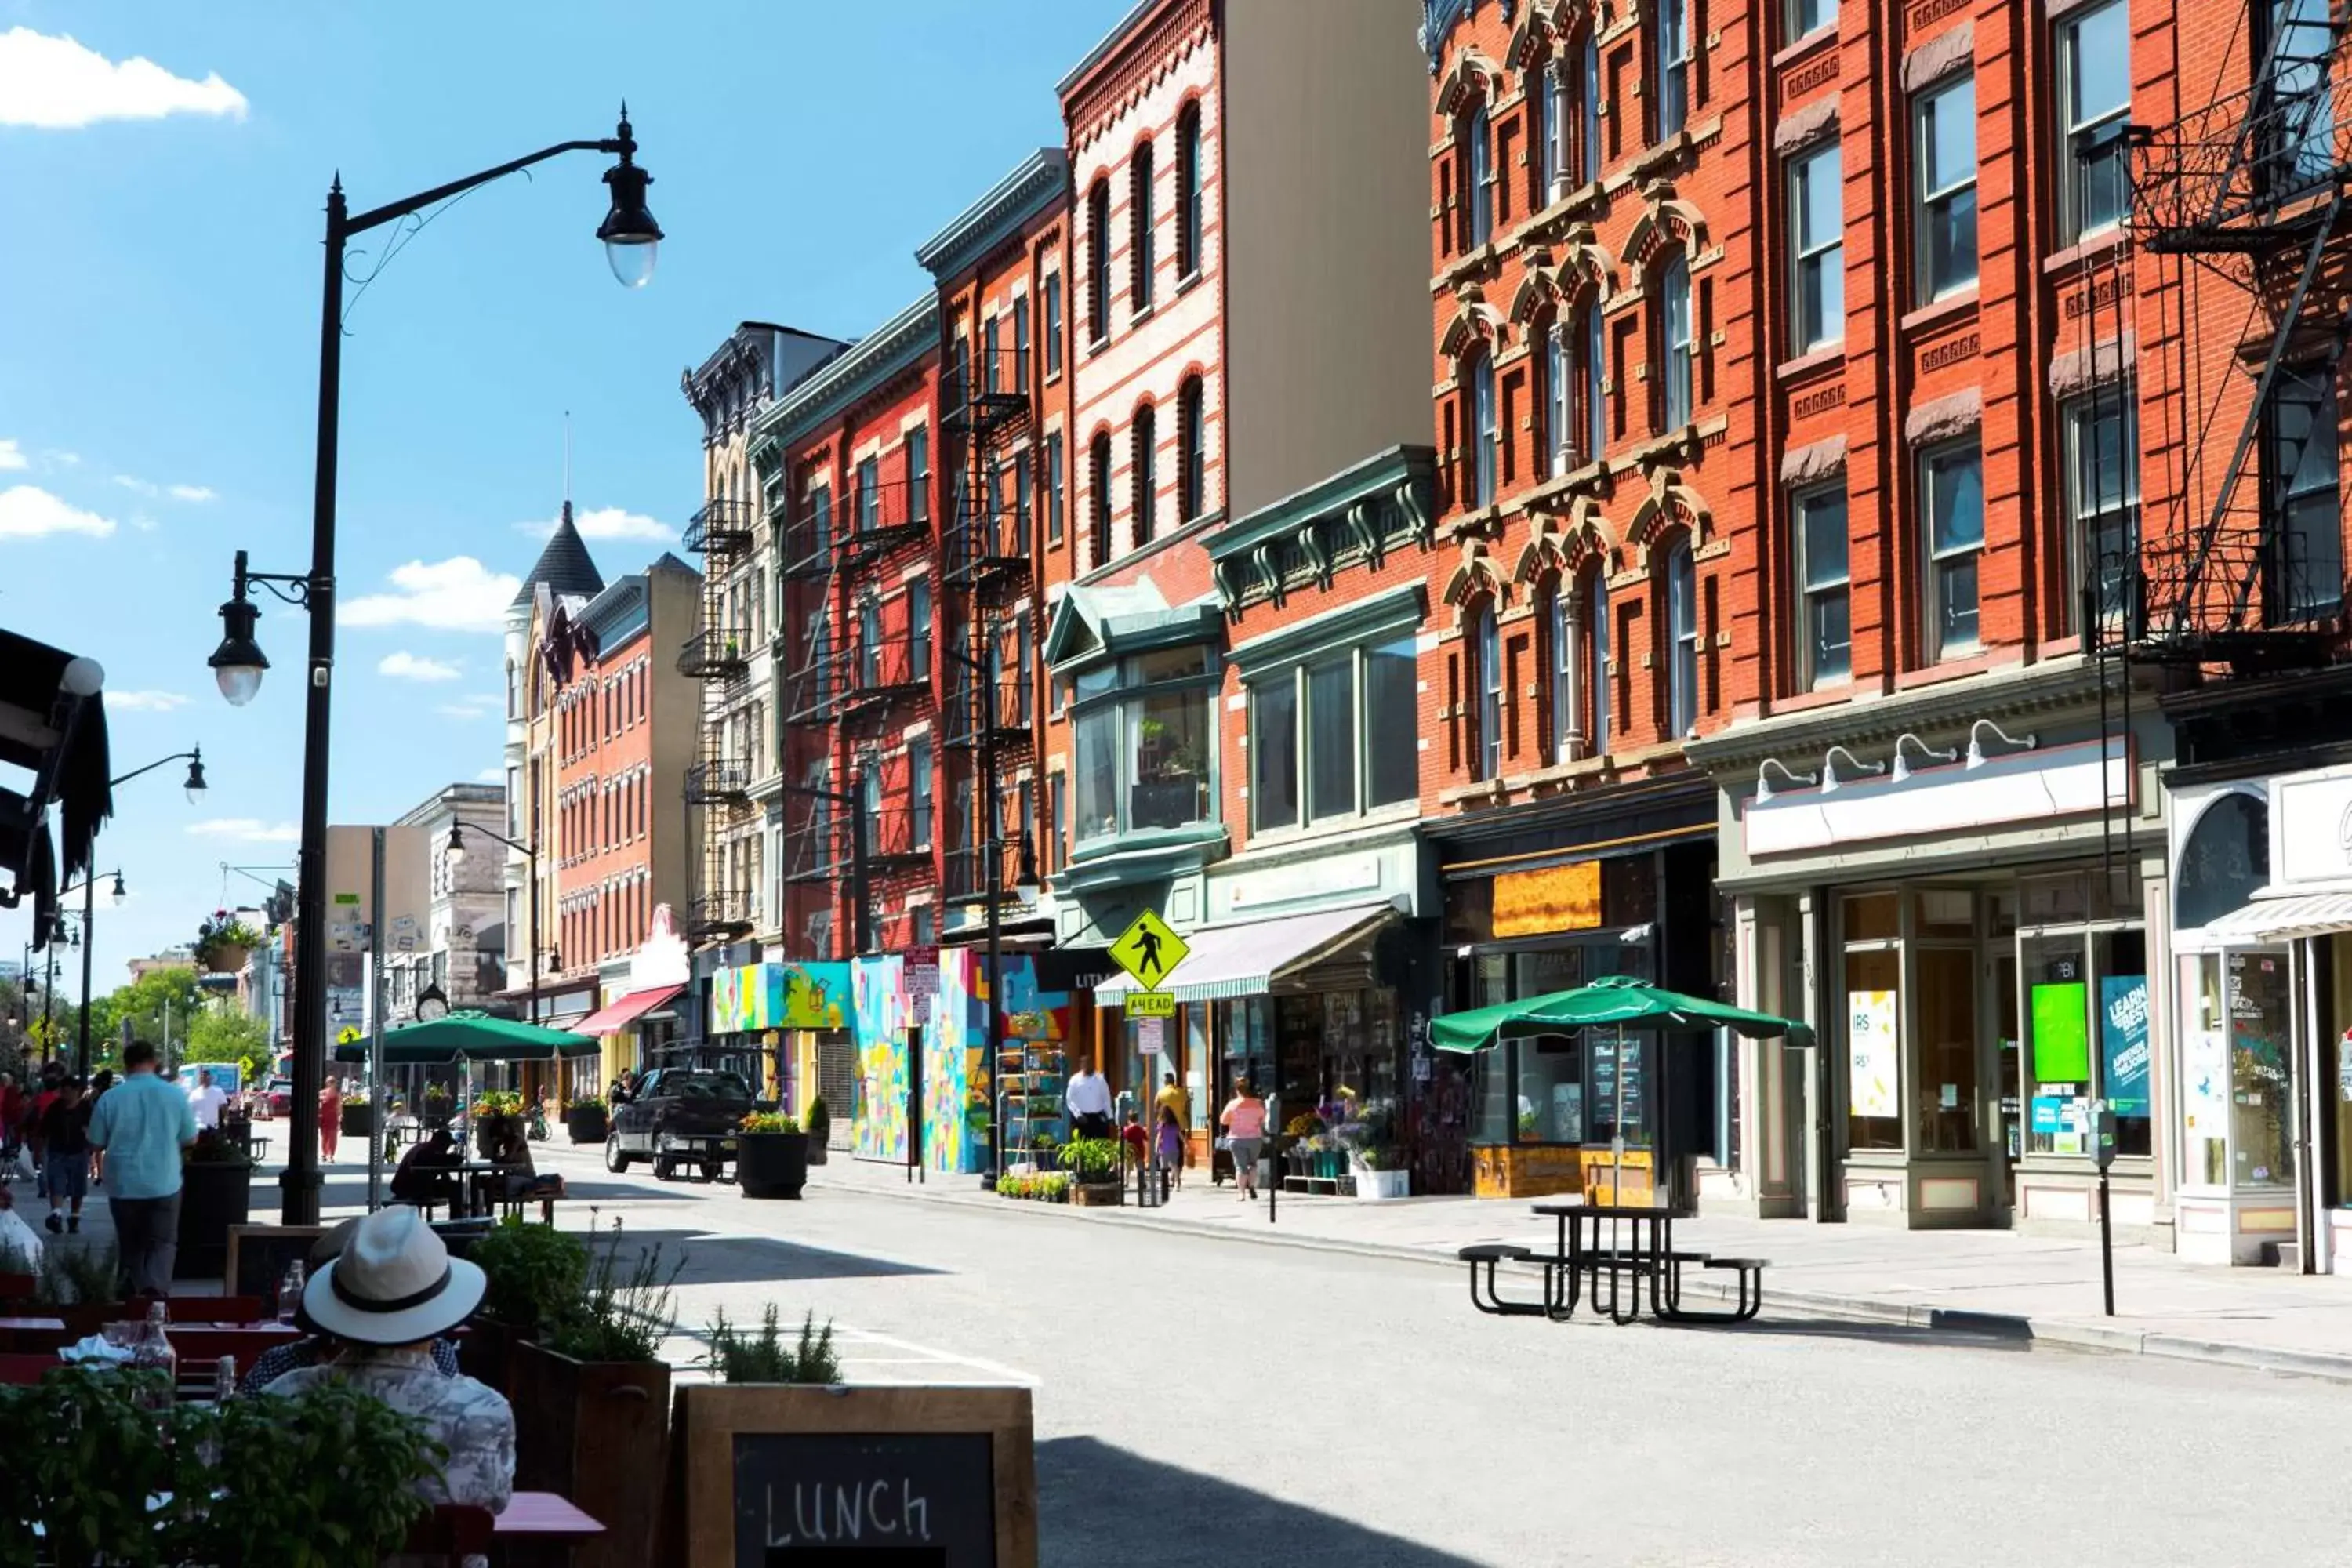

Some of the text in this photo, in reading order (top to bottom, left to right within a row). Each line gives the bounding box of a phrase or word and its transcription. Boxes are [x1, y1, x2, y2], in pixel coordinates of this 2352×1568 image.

[1130, 997, 1171, 1011] AHEAD
[2109, 983, 2147, 1021] LEARN
[1853, 1014, 1870, 1031] IRS
